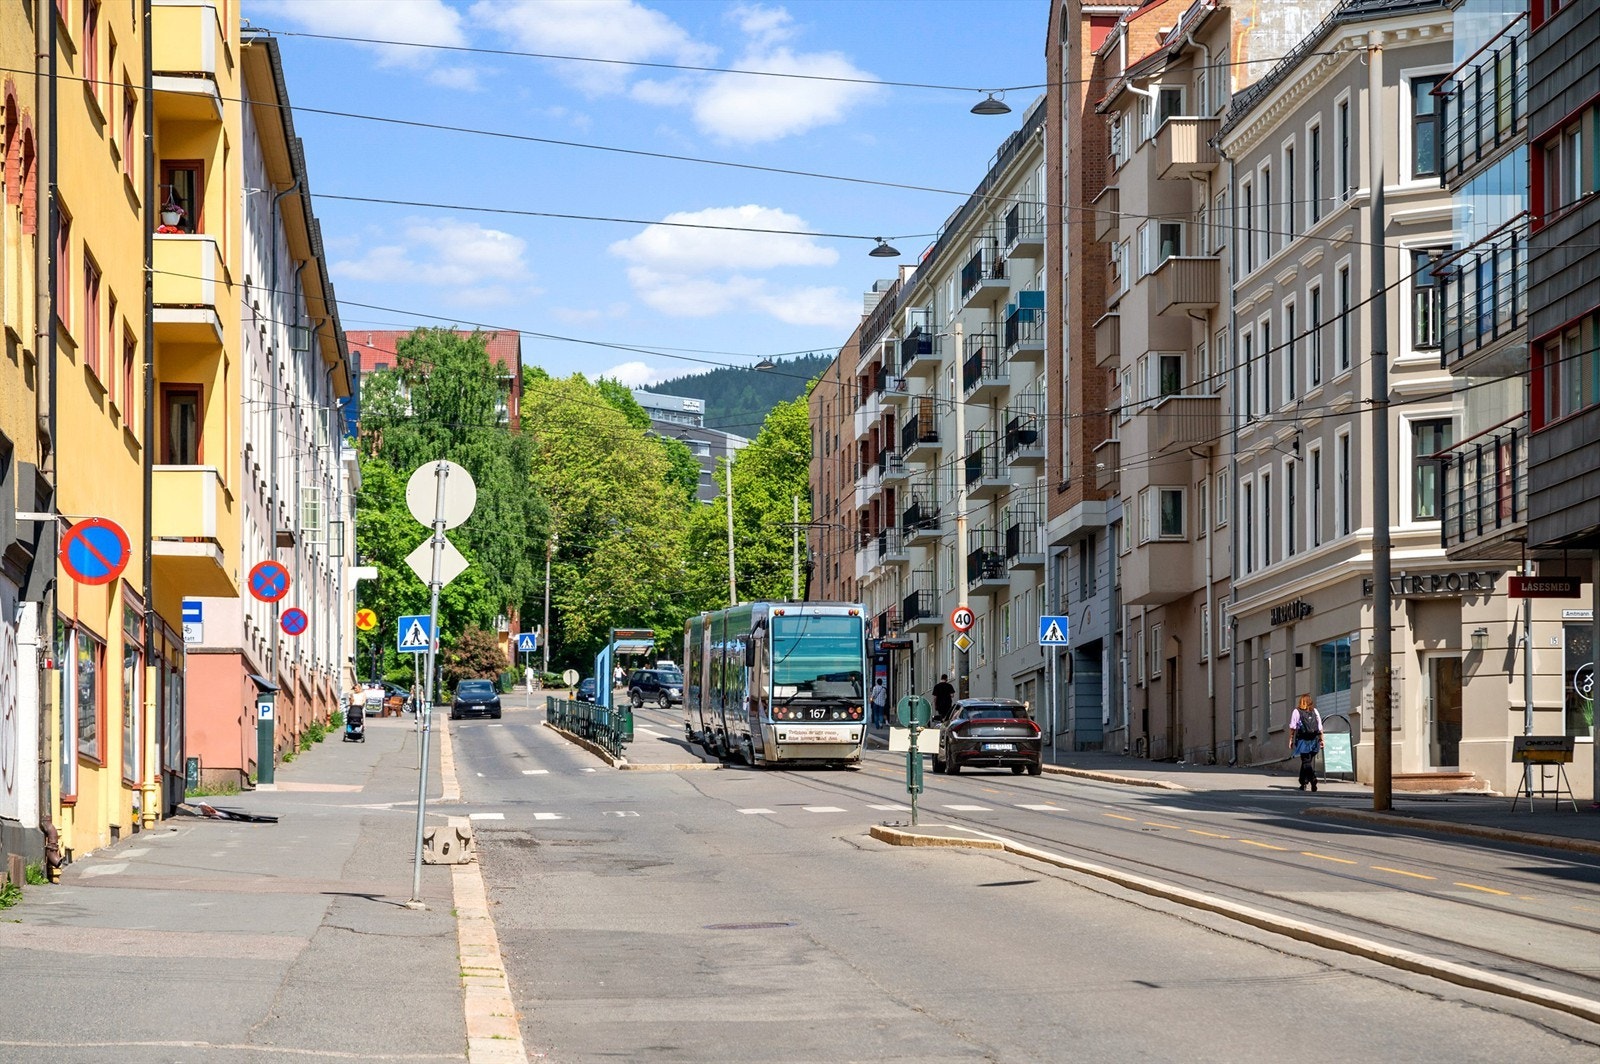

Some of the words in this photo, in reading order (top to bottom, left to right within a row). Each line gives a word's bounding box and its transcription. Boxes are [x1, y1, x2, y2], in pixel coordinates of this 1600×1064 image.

[1363, 571, 1500, 596] HIRPORT
[955, 613, 971, 625] 40
[261, 705, 270, 717] P
[809, 708, 826, 719] 167
